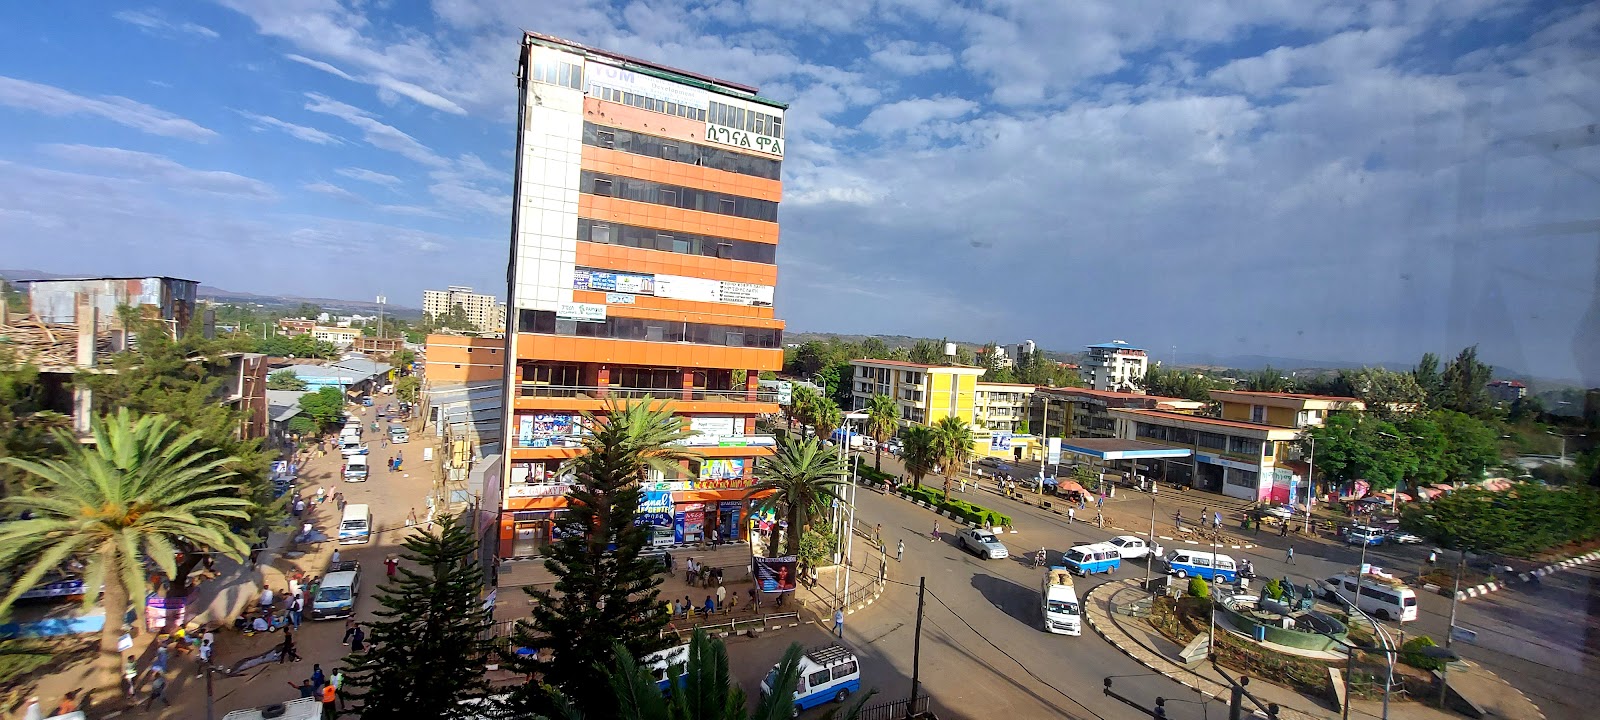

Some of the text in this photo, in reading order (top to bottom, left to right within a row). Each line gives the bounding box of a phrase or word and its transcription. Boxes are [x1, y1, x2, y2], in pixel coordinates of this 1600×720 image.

[596, 65, 635, 84] YOM
[651, 82, 695, 98] Development
[707, 125, 782, 154] ሲግናል ሞል
